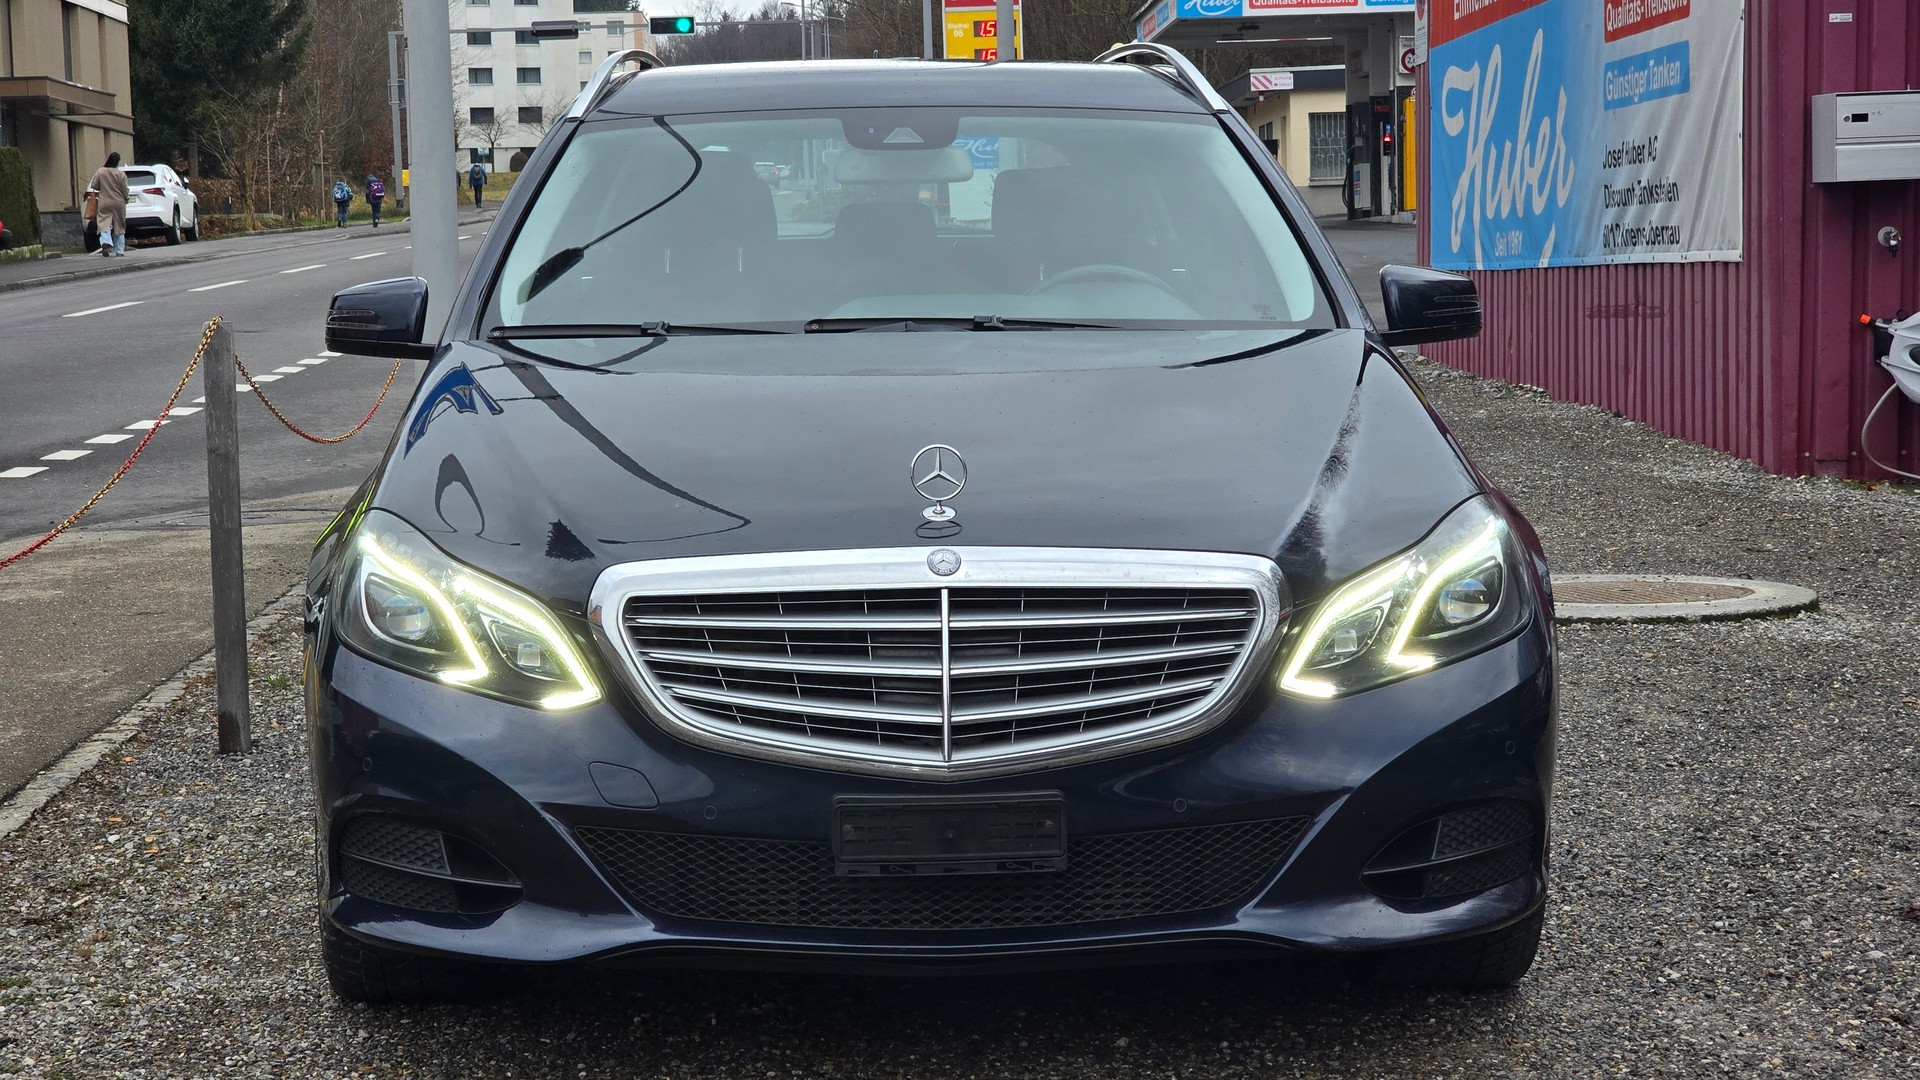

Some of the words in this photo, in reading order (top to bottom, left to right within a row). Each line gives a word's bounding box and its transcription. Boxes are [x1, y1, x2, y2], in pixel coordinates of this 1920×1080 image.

[980, 21, 995, 37] 1.5
[1606, 66, 1648, 103] Günstiger
[1649, 56, 1680, 91] Tanken
[1442, 28, 1575, 269] Huber
[1602, 141, 1625, 170] Josef
[1624, 139, 1646, 167] Huber
[1647, 135, 1658, 163] AG
